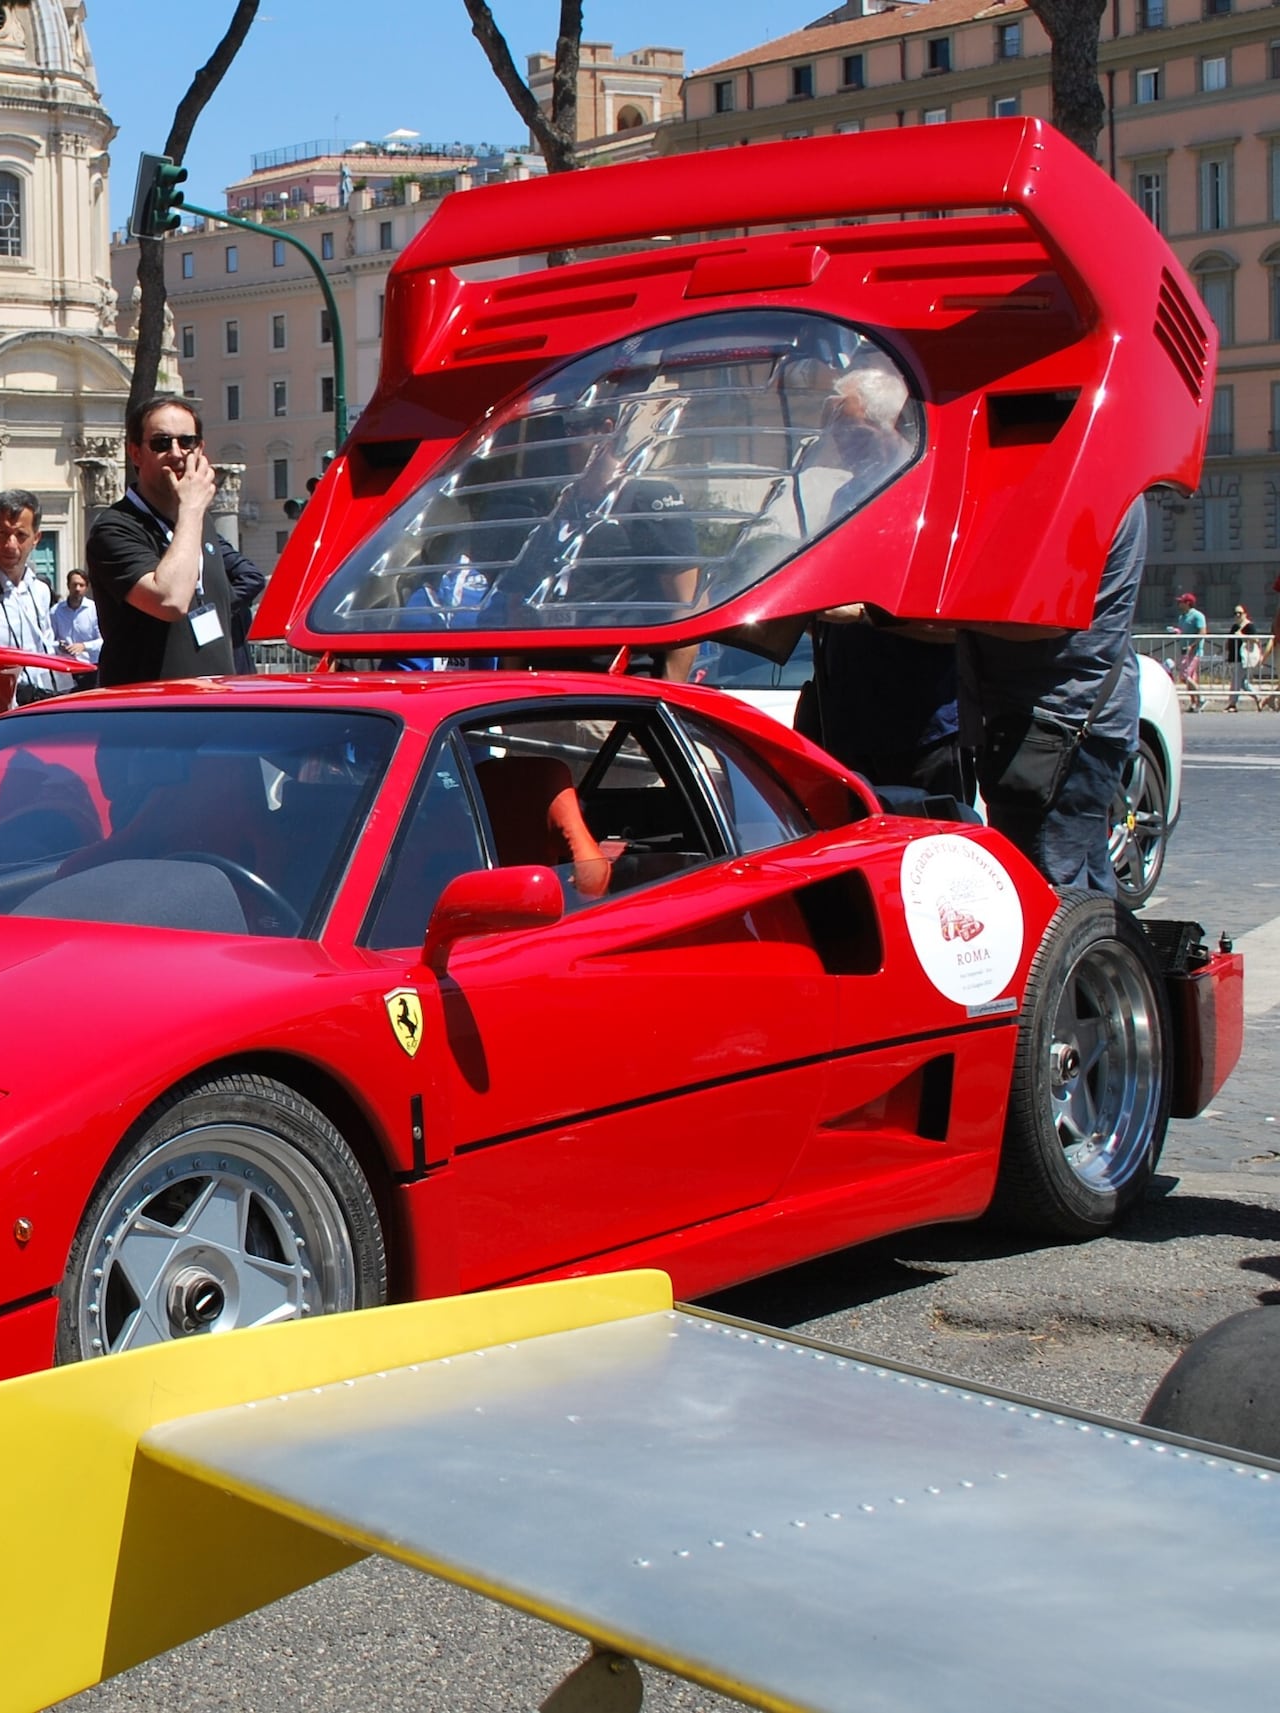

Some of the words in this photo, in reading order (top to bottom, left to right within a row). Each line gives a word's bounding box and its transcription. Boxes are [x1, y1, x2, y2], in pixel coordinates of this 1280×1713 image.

[910, 841, 934, 885] Grand
[962, 845, 1004, 892] Storico
[956, 948, 991, 966] ROMA
